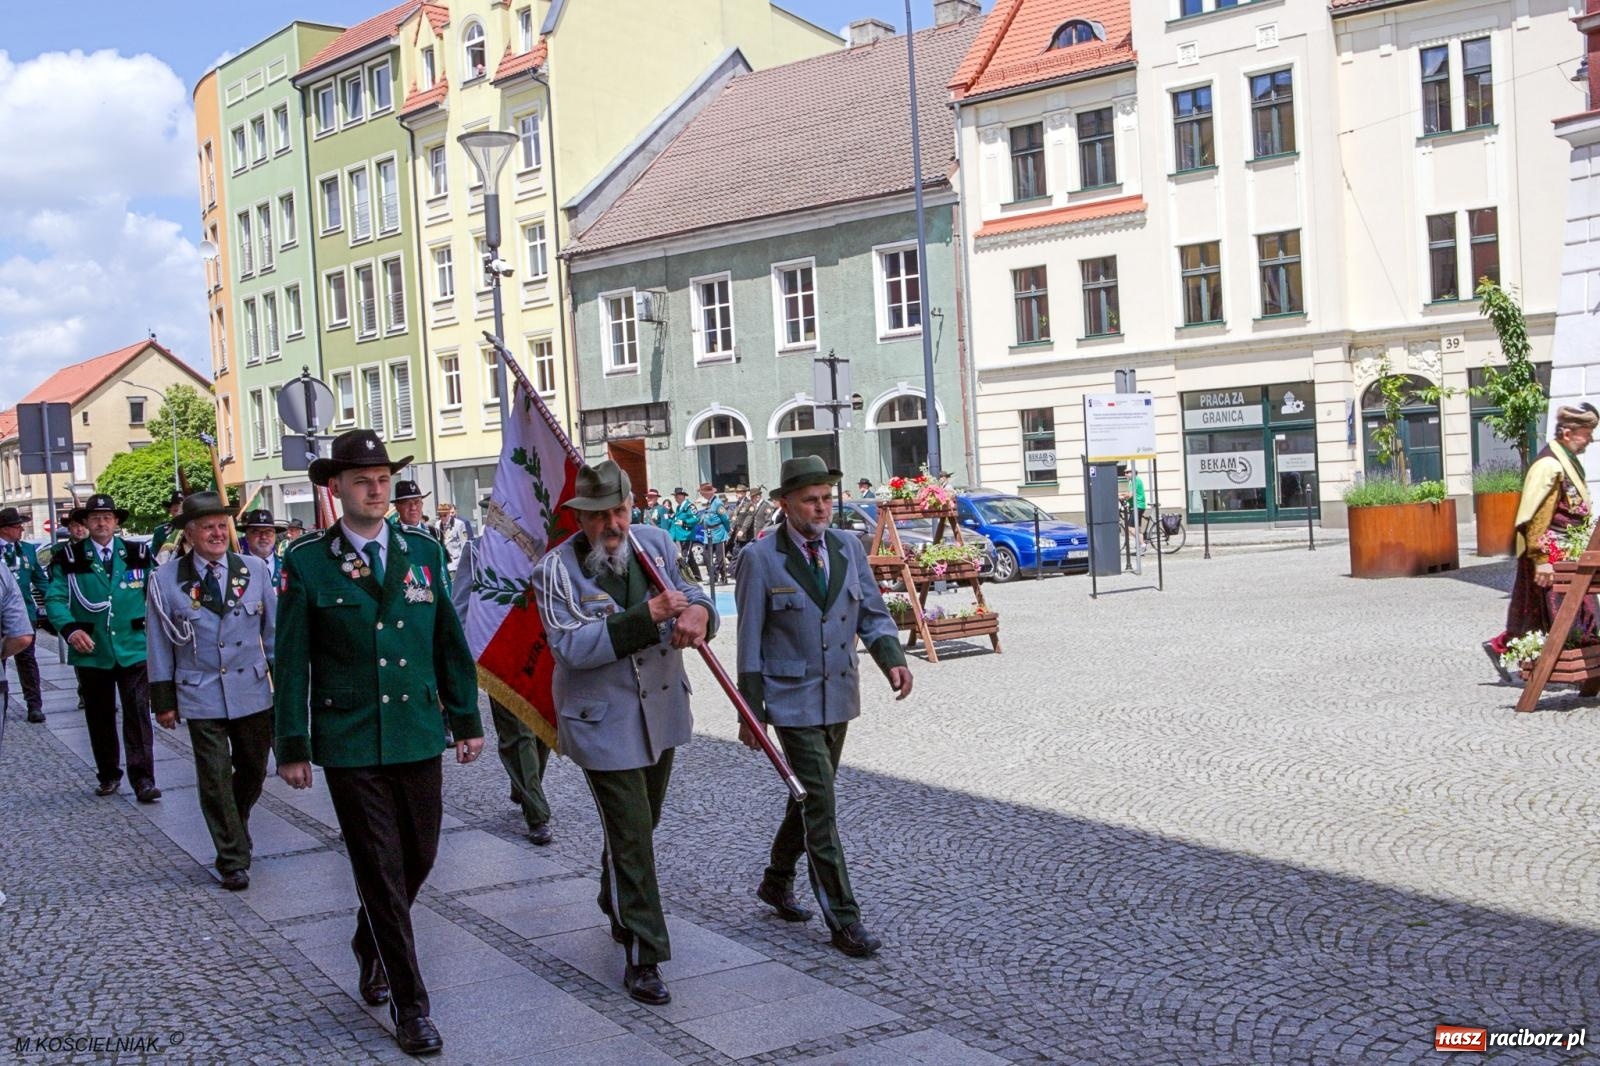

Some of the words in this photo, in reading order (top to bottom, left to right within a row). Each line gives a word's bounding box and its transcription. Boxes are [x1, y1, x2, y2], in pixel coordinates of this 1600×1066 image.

[1446, 338, 1460, 349] 39
[1200, 393, 1231, 407] PRACA
[1232, 391, 1245, 404] ZA
[1202, 410, 1245, 424] GRANICĄ
[1200, 457, 1237, 470] BEKAM
